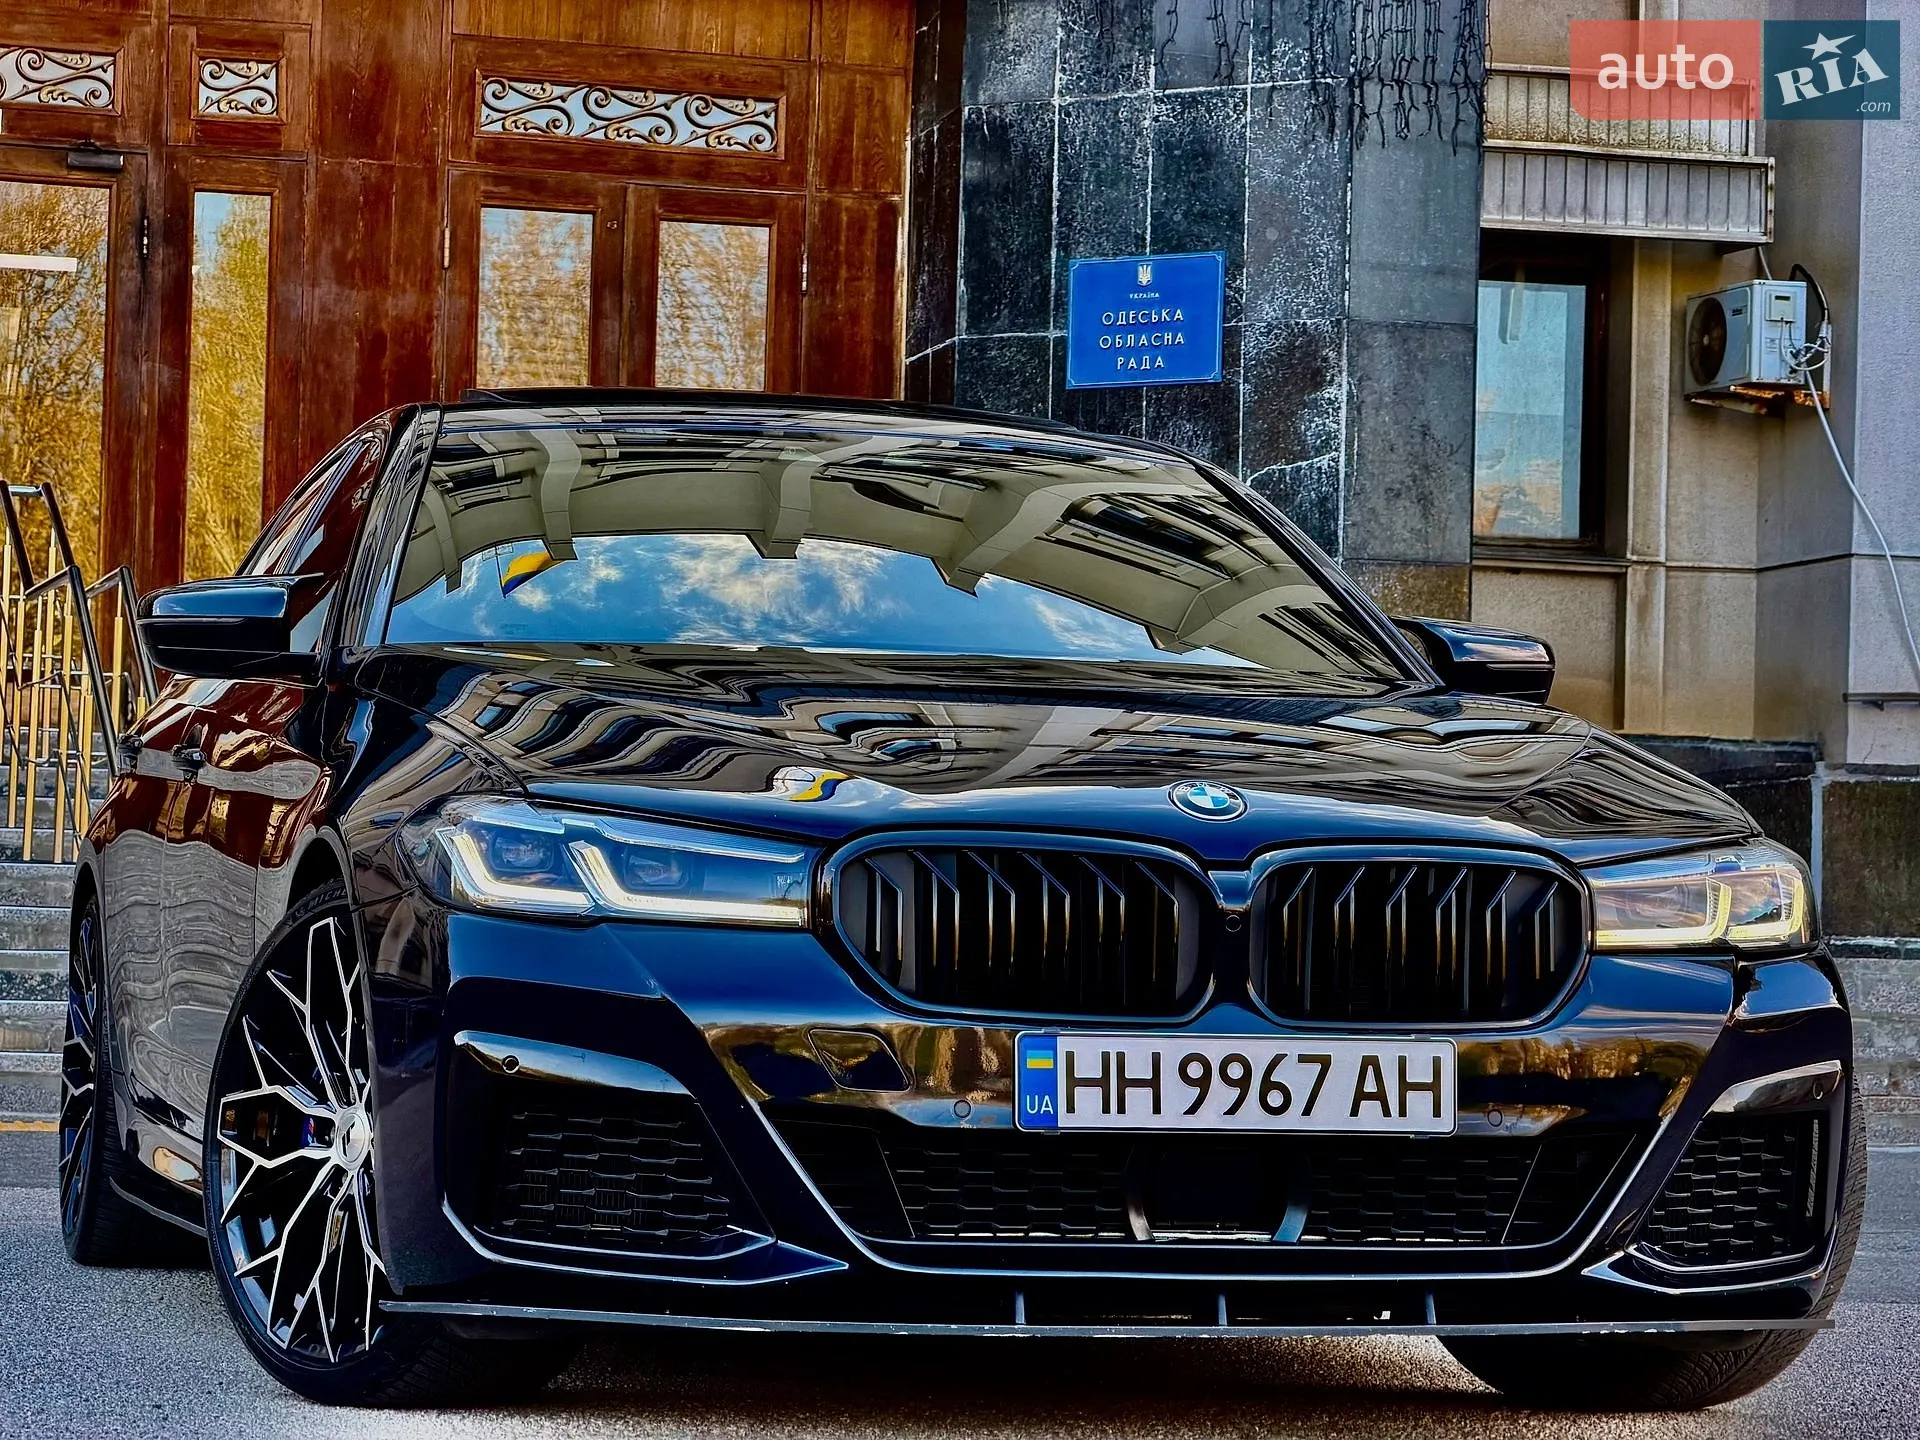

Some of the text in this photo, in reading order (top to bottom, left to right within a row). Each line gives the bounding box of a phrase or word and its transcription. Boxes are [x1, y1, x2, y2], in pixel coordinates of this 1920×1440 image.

[1102, 308, 1184, 326] ОДЕСЬКА
[1099, 332, 1185, 349] ОБЛАСНА
[1117, 356, 1165, 370] РАДА
[1064, 1050, 1442, 1119] HH 9967 AH
[1026, 1094, 1054, 1115] UA
